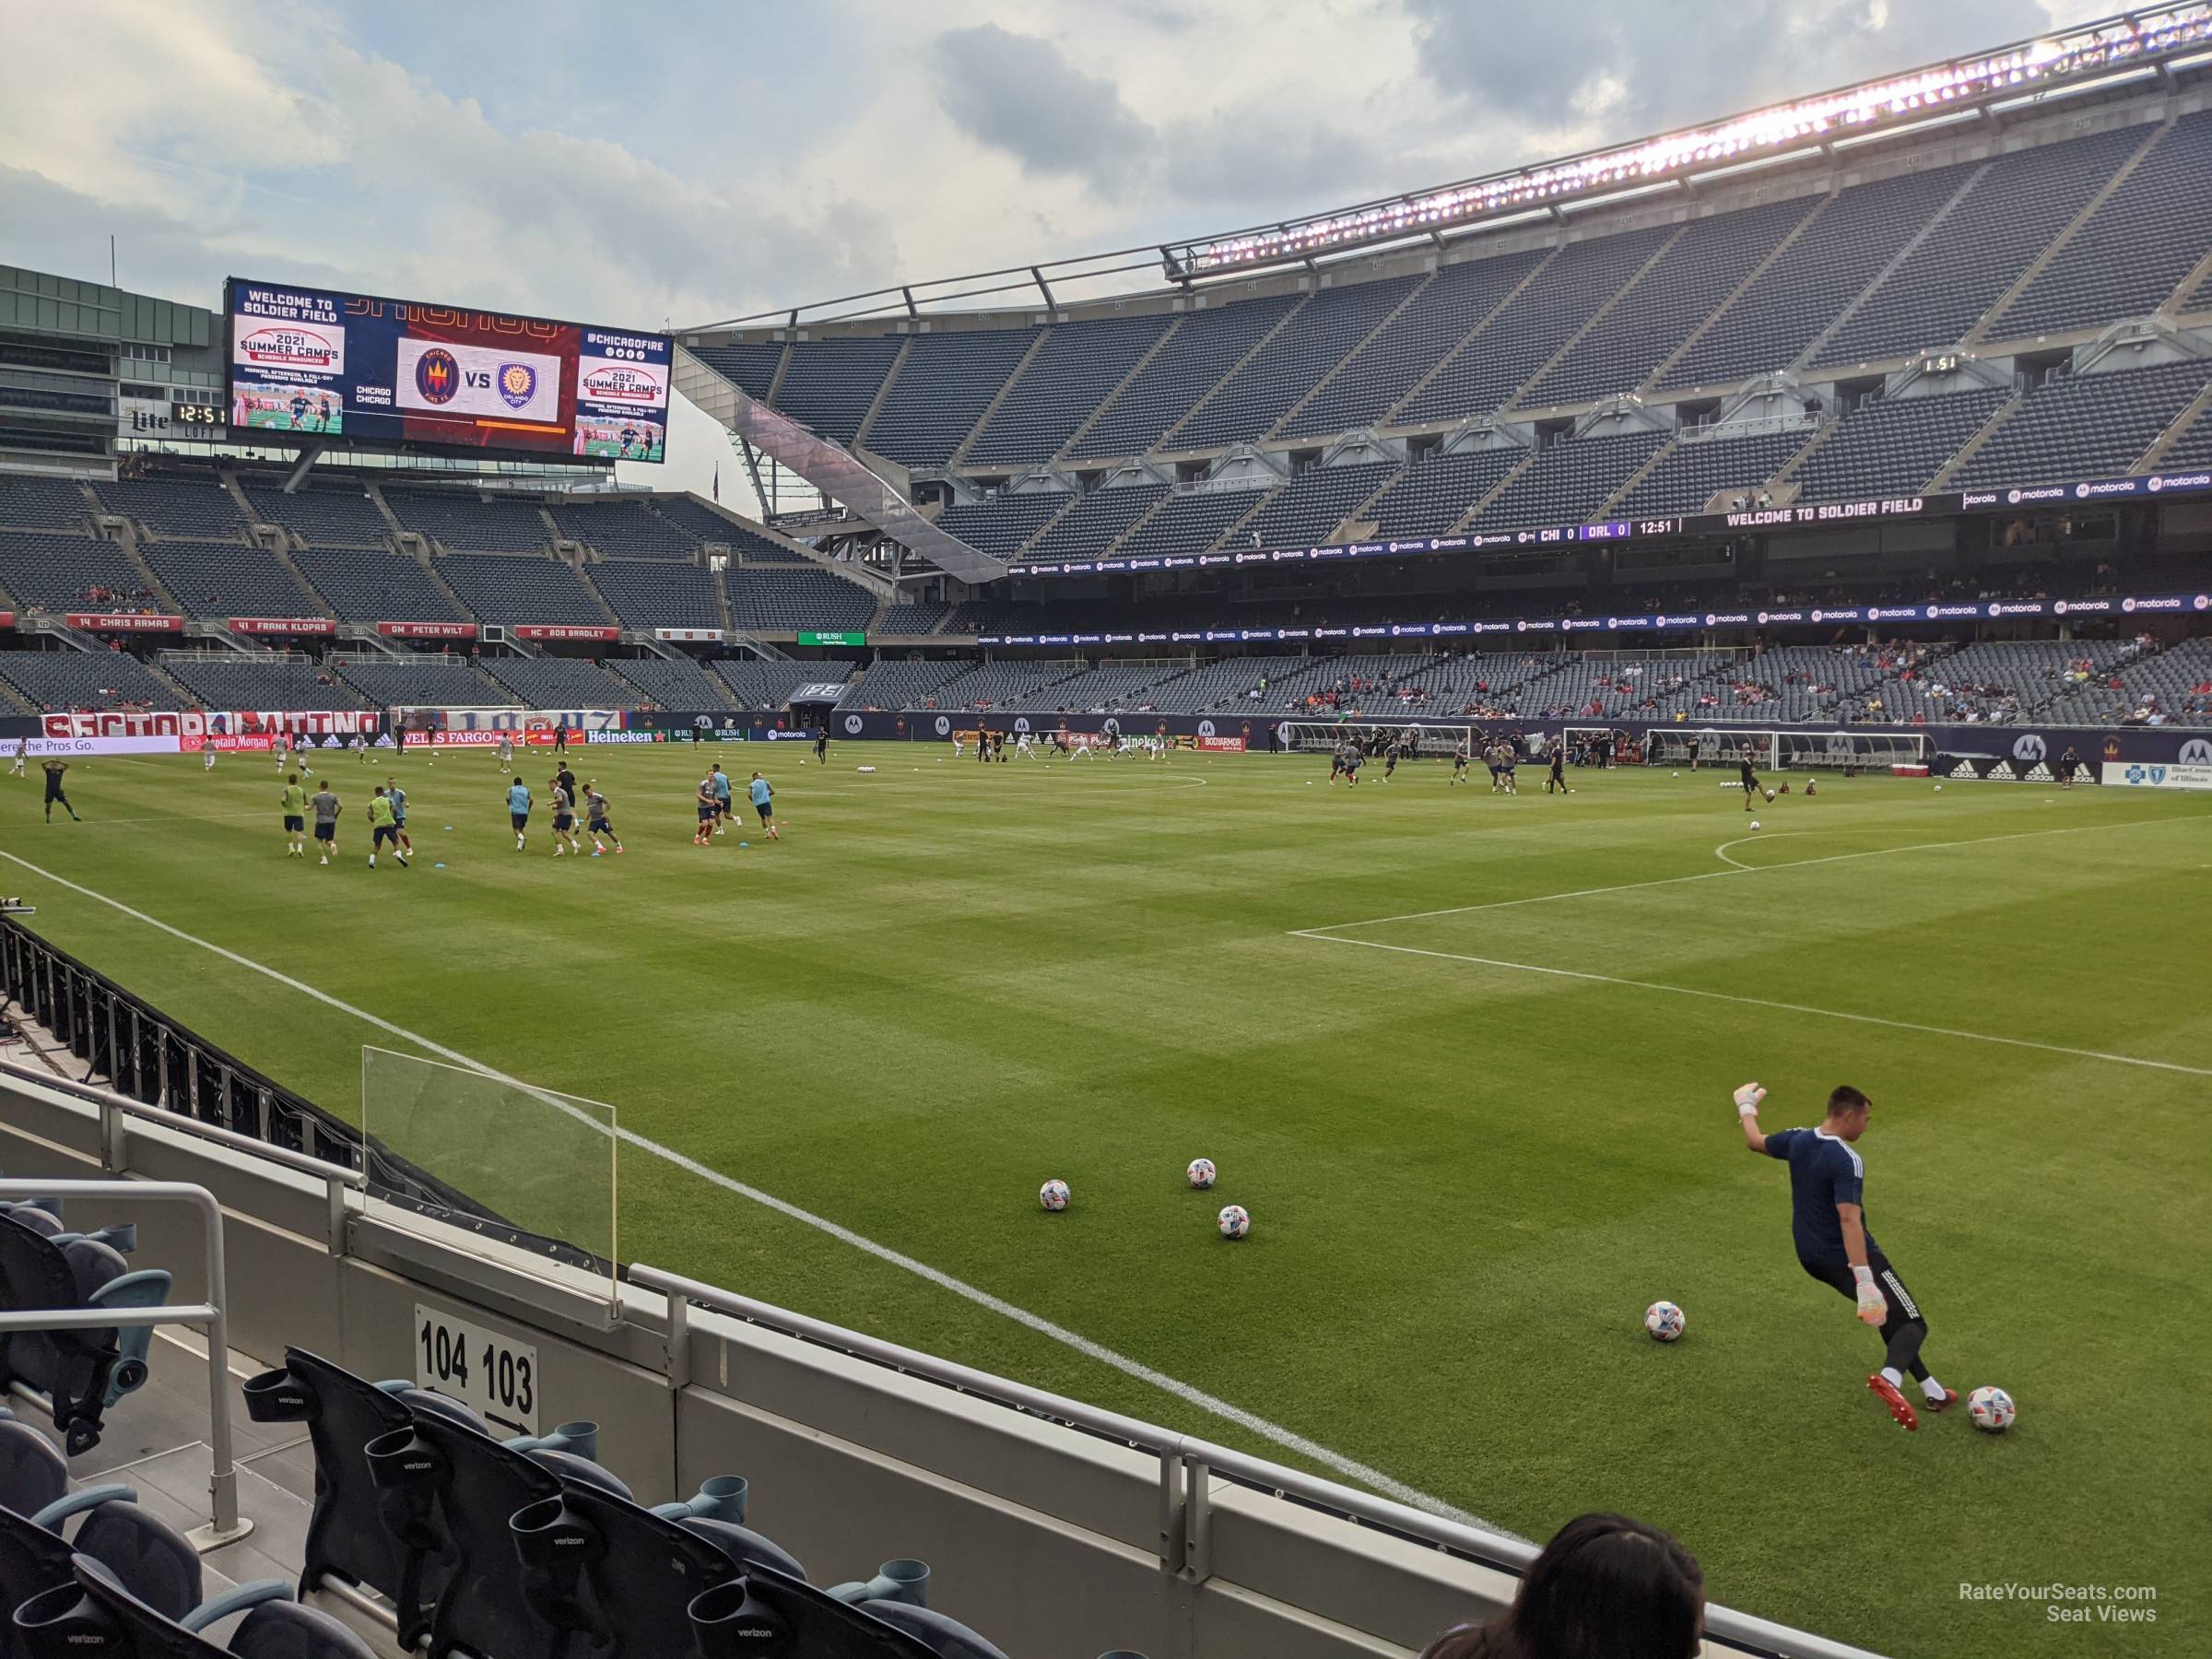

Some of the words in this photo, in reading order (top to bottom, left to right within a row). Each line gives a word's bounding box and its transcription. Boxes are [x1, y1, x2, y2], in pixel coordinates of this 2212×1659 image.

[249, 290, 312, 308] WELCOME
[317, 300, 332, 310] TO
[244, 302, 297, 318] SOLDIER
[302, 310, 337, 323] FIELD
[276, 335, 304, 346] 2021
[588, 334, 664, 351] @CHICAGOFIRE
[241, 341, 292, 354] SUMMER
[298, 347, 339, 359] CAMPS
[426, 350, 452, 362] CHICAGO
[465, 371, 490, 389] VS
[612, 372, 635, 382] 2021
[356, 385, 391, 396] CHICAGO
[582, 378, 625, 391] SUMMER
[629, 384, 662, 394] CAMPS
[356, 394, 391, 406] CHICAGO
[181, 406, 225, 423] 12:51
[132, 411, 169, 431] Lite
[184, 426, 214, 438] LOFT
[2022, 489, 2063, 500] motorola
[2090, 483, 2135, 493] motorola
[2163, 476, 2209, 487] motorola
[1727, 510, 1792, 526] WELCOME
[1797, 508, 1813, 521] TO
[1818, 502, 1877, 519] SOLDIER
[1882, 499, 1923, 514] FIELD
[1541, 530, 1559, 540] CHI
[1568, 529, 1574, 539] 0
[1589, 526, 1610, 537] ORL
[1618, 524, 1625, 535] 0
[1641, 521, 1671, 534] 12:51
[1879, 608, 1915, 617] motorola
[1938, 606, 1977, 615] motorola
[2002, 604, 2041, 612] motorola
[2068, 601, 2109, 610] motorola
[2136, 599, 2181, 608] motorola
[79, 618, 90, 626] 14
[100, 618, 130, 627] CHRIS
[135, 619, 169, 628] ARMAS
[257, 622, 288, 630] FRANK
[236, 735, 268, 748] Morgan
[449, 732, 492, 743] FARGO
[588, 730, 652, 743] Heineken
[1206, 737, 1241, 747] BODYARMOR
[46, 741, 71, 750] Pros
[76, 740, 94, 750] Go.
[1950, 771, 1979, 779] adidas
[1987, 771, 2017, 780] adidas
[2024, 773, 2054, 782] adidas
[421, 1320, 467, 1388] 104
[483, 1344, 533, 1415] 103
[278, 1395, 303, 1405] verizon
[404, 1461, 431, 1469] verizon
[554, 1536, 584, 1546] verizon
[66, 1634, 103, 1645] verizon
[738, 1629, 771, 1638] verizon
